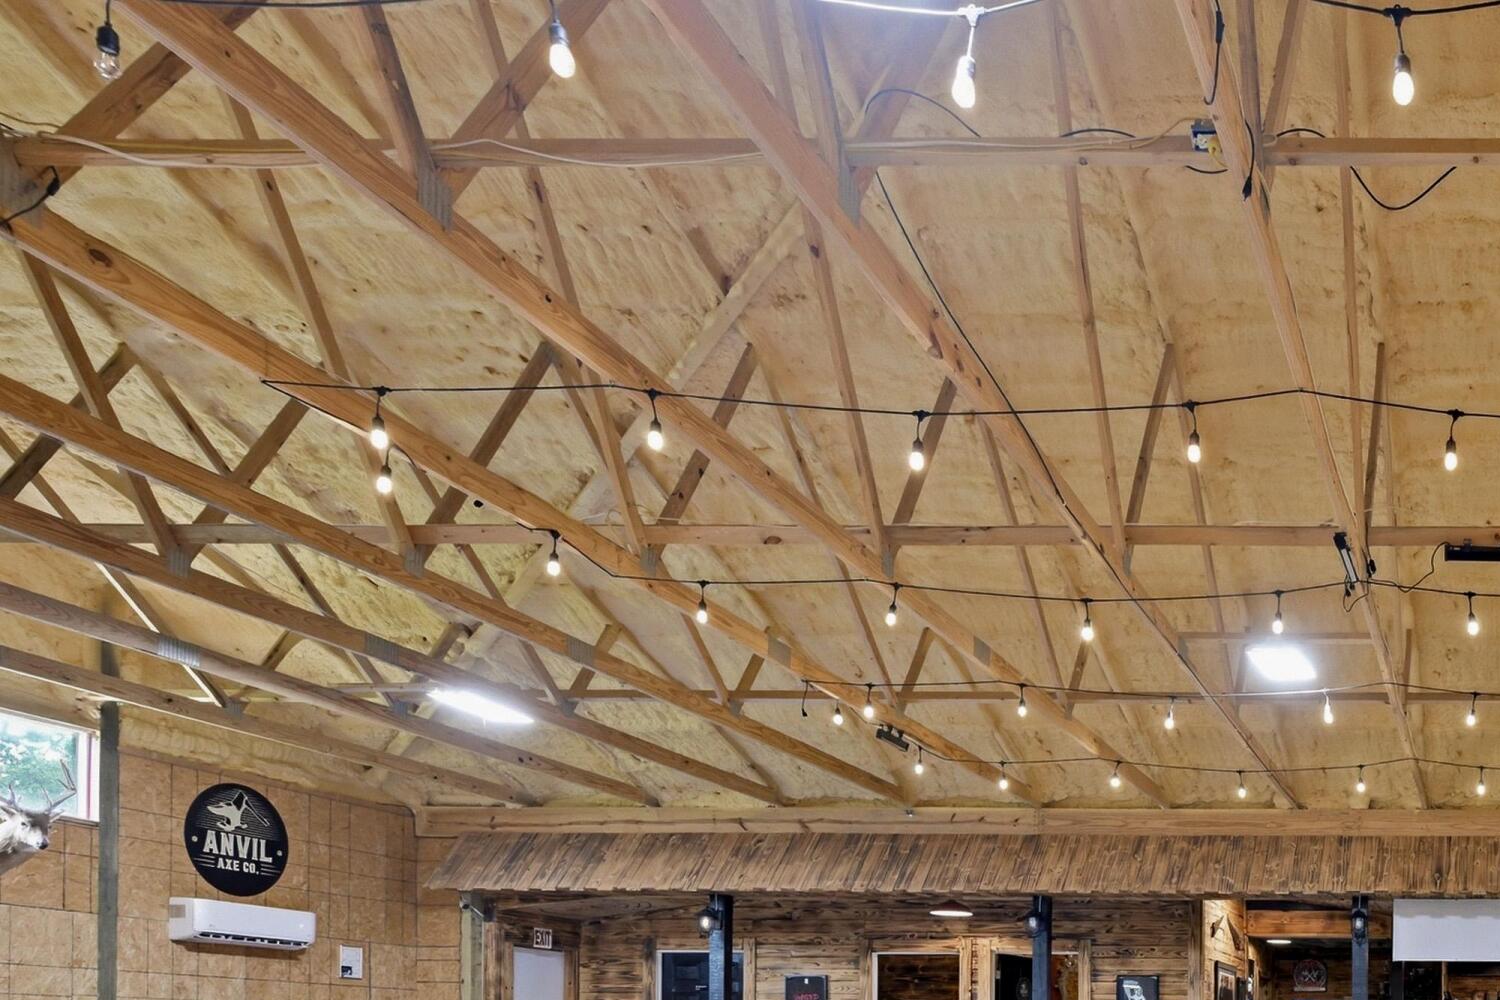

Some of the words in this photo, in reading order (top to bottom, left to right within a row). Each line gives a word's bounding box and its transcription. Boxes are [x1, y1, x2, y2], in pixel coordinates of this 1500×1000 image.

[202, 829, 273, 863] ANVIL
[217, 857, 240, 872] AXE
[242, 861, 260, 875] CO.
